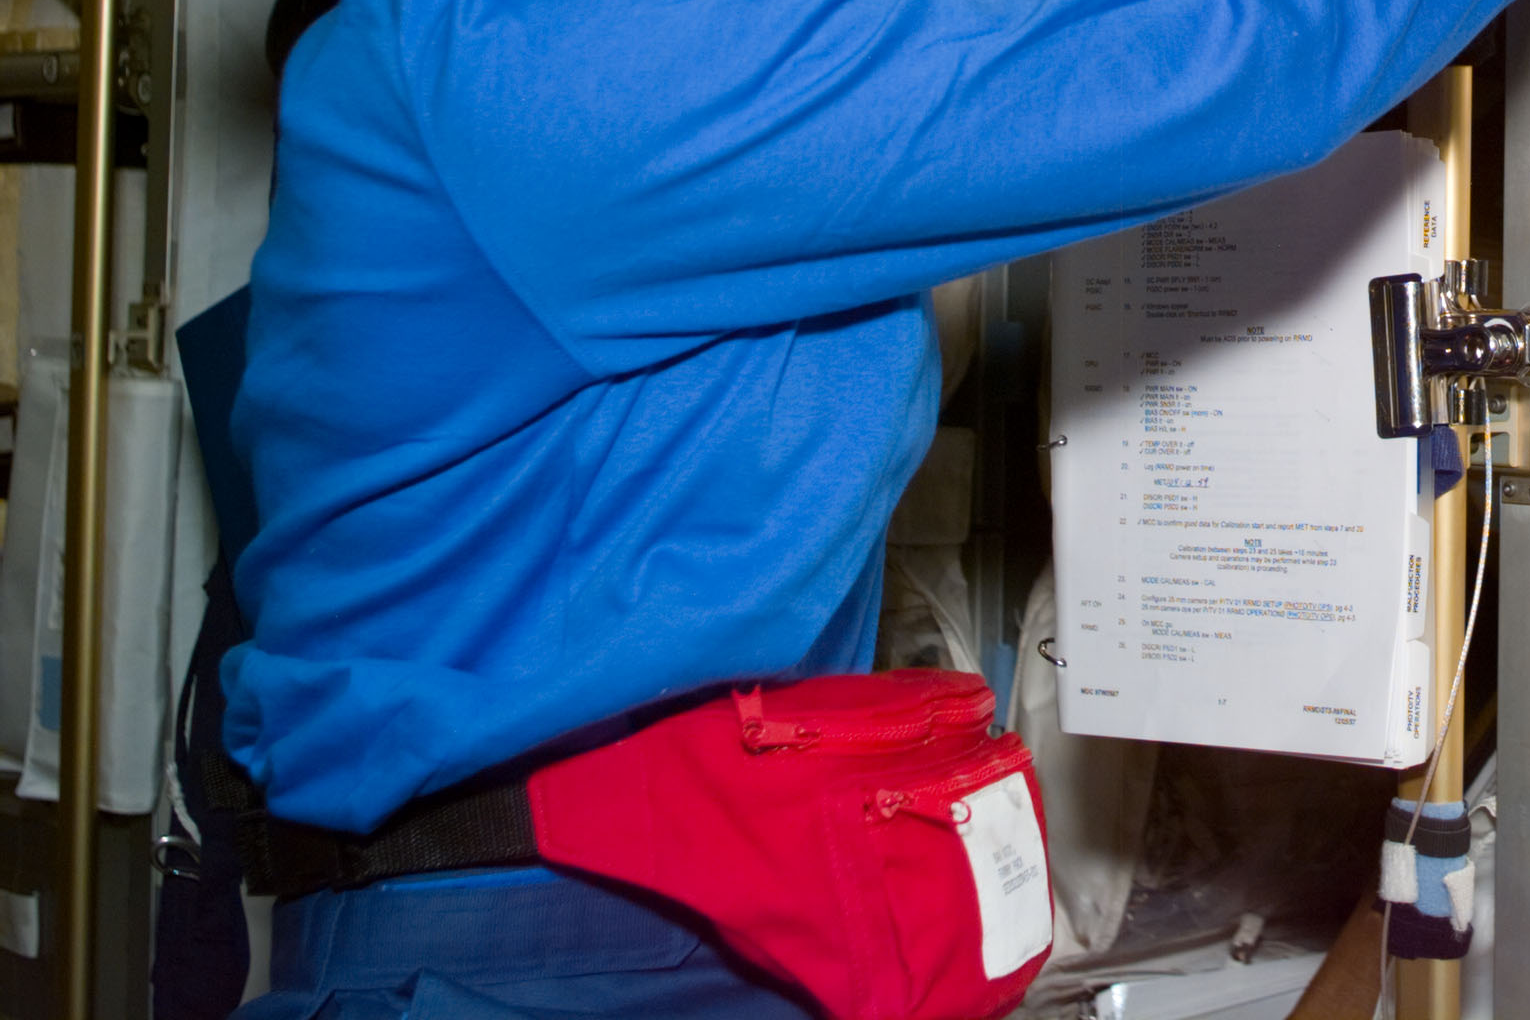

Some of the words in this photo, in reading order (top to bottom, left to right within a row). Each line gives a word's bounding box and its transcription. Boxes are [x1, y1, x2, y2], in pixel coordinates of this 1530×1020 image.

[1423, 200, 1431, 248] REFERENCE
[1246, 326, 1264, 335] NOTE
[1244, 539, 1262, 547] NOTE
[1412, 556, 1422, 613] PROCEDURES
[1413, 686, 1421, 740] OPERATIONS
